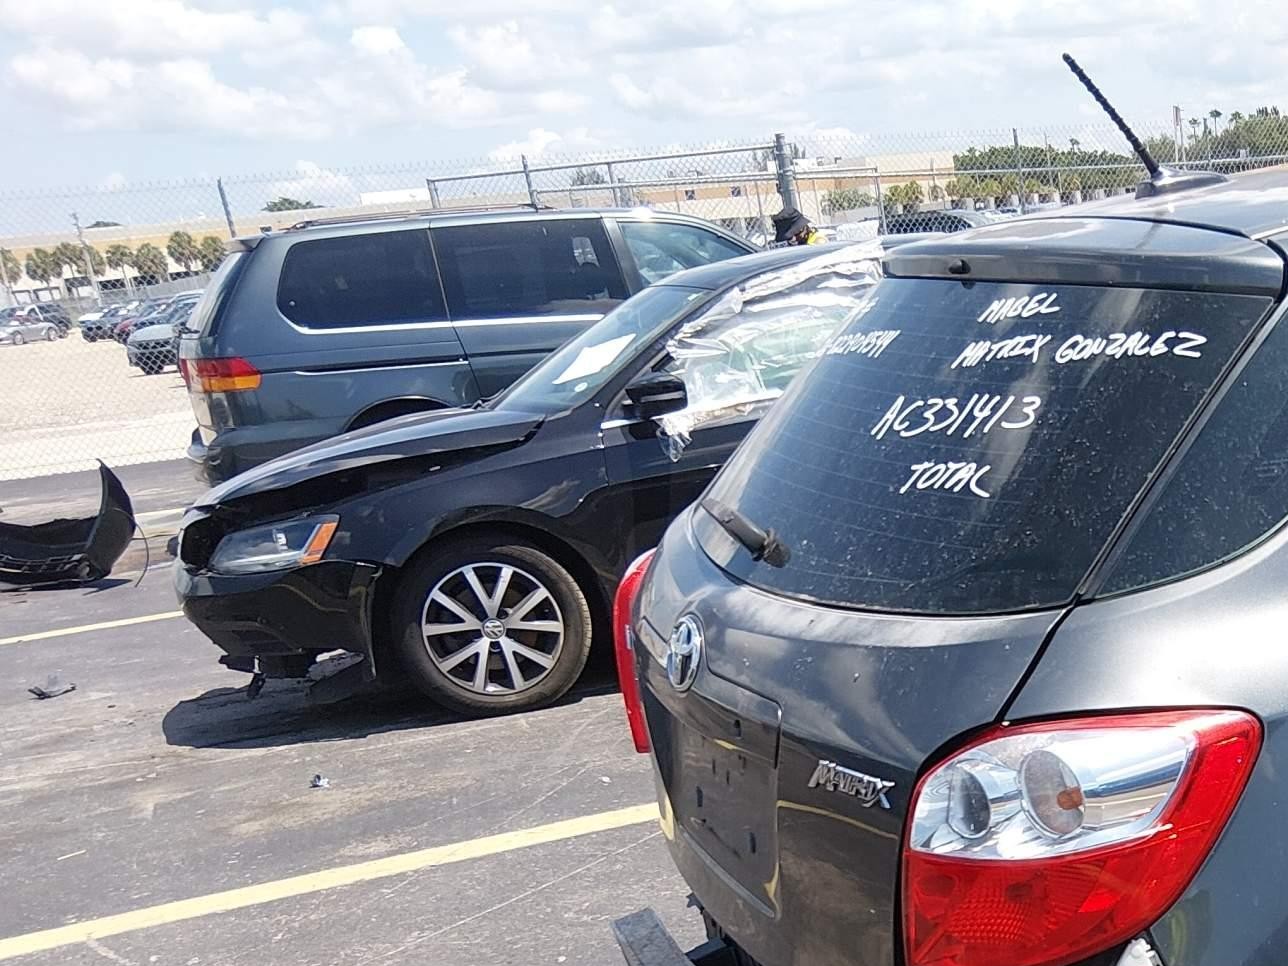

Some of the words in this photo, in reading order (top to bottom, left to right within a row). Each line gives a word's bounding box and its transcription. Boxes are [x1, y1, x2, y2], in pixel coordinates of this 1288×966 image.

[977, 293, 1061, 323] MABEL
[951, 334, 1052, 369] MATRIX
[1055, 331, 1207, 364] GONZALEZ
